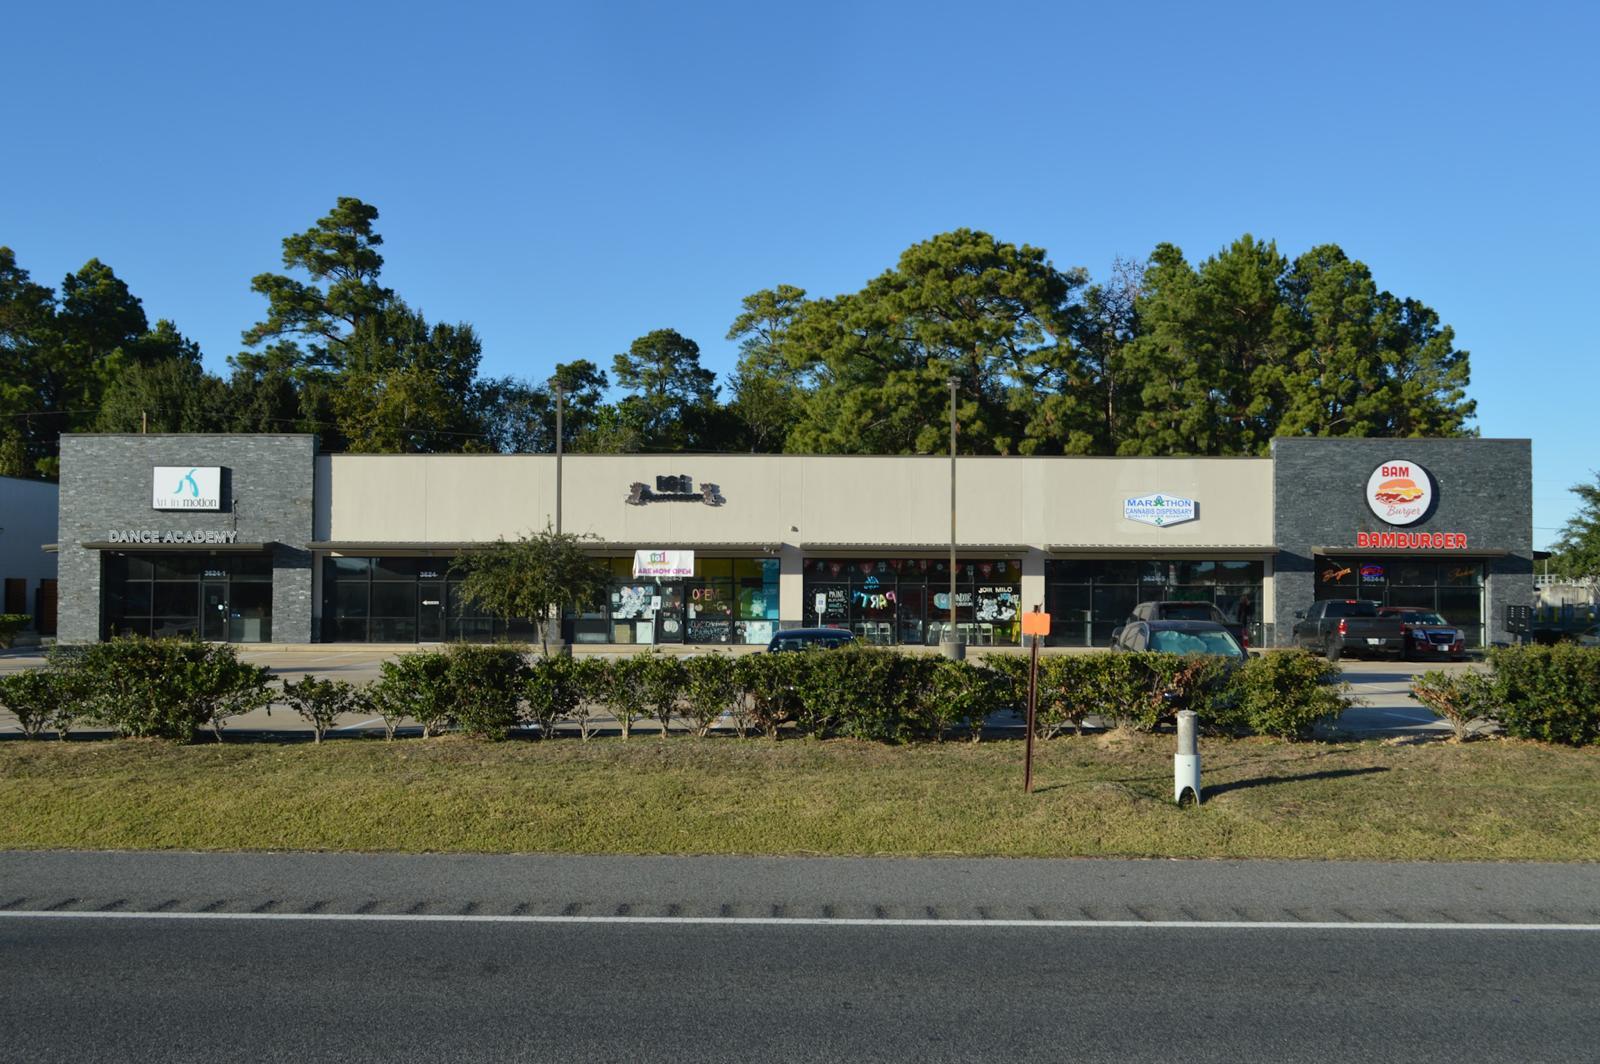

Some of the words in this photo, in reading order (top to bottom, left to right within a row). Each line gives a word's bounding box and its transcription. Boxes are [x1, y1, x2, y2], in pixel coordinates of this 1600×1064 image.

[1382, 466, 1410, 477] BAM
[183, 497, 217, 507] motion
[1386, 504, 1421, 518] Burger
[108, 529, 160, 544] DANCE
[162, 529, 237, 544] ACADEMY
[1357, 532, 1467, 549] BAMBURGER
[672, 567, 692, 575] OPEN
